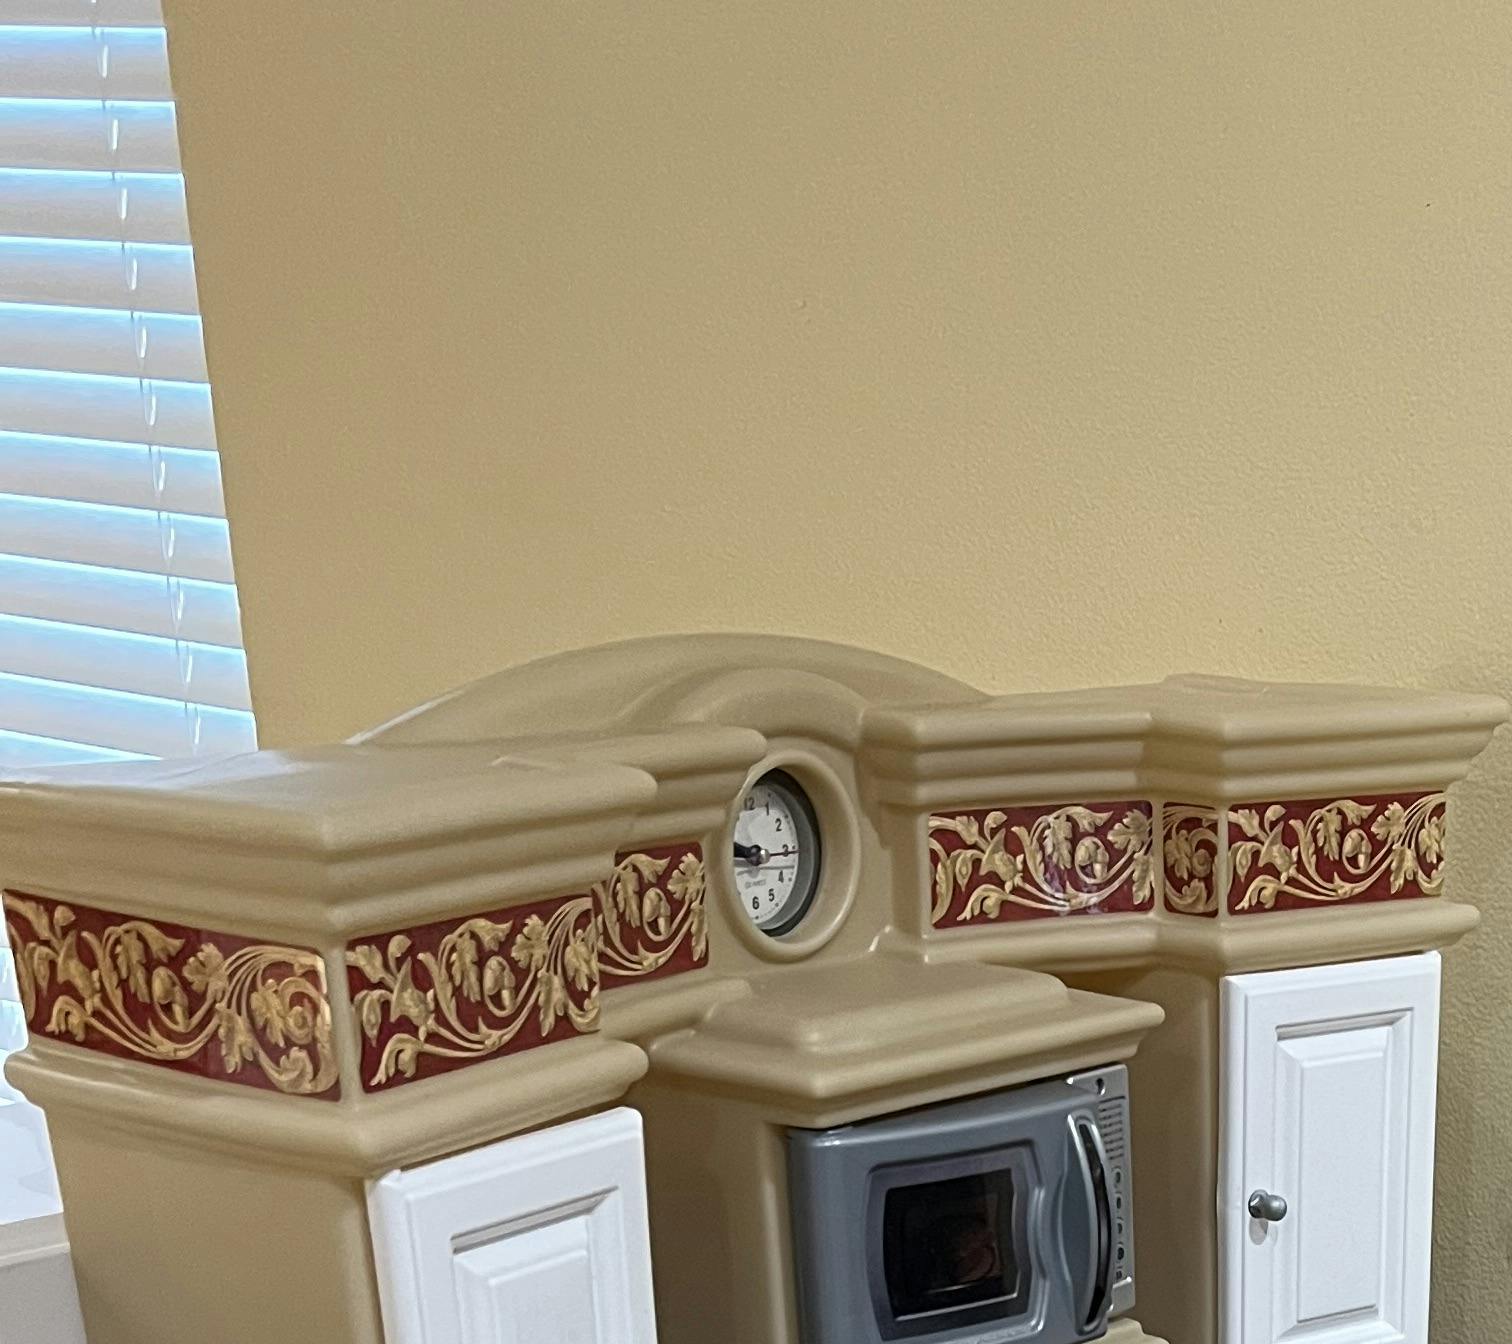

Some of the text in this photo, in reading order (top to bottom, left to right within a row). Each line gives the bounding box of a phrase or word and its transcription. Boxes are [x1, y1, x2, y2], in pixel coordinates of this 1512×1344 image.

[775, 818, 782, 832] 2
[778, 870, 784, 883] 4
[768, 888, 775, 902] 5
[752, 896, 760, 910] 6
